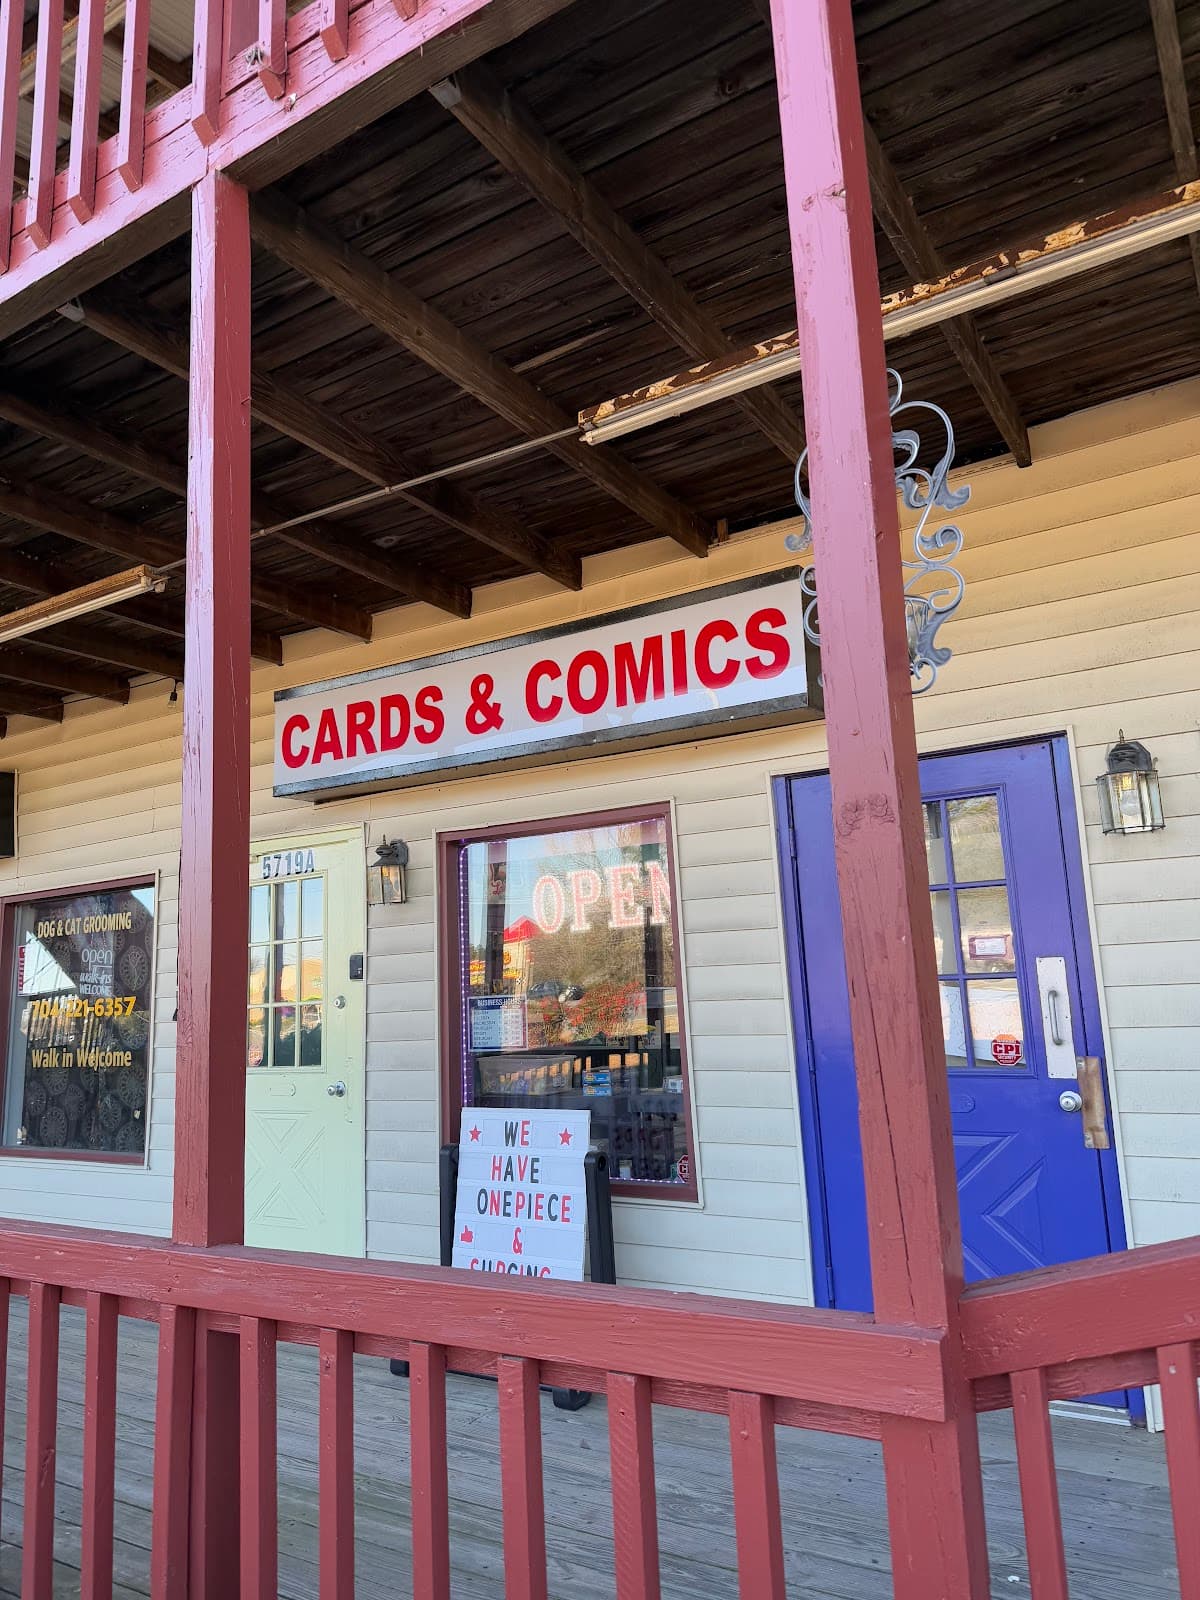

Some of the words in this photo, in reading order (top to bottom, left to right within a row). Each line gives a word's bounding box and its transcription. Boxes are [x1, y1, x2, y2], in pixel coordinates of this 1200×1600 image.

[281, 685, 445, 769] CARDS
[465, 673, 504, 735] &
[525, 607, 791, 722] COMICS
[262, 849, 315, 879] 5719A
[533, 861, 671, 934] OPEN
[37, 921, 56, 938] DOG
[56, 919, 64, 937] &
[64, 917, 82, 935] CAT
[83, 911, 132, 934] GROOMING
[81, 948, 113, 971] open
[477, 998, 503, 1006] BUSINESS
[31, 1047, 60, 1069] Walk
[61, 1047, 74, 1068] in
[76, 1046, 132, 1068] Welcome
[993, 1043, 1020, 1055] CPI
[504, 1120, 531, 1147] WE
[491, 1154, 540, 1184] HAVE
[476, 1188, 572, 1223] ONEPIECE
[511, 1226, 523, 1254] &
